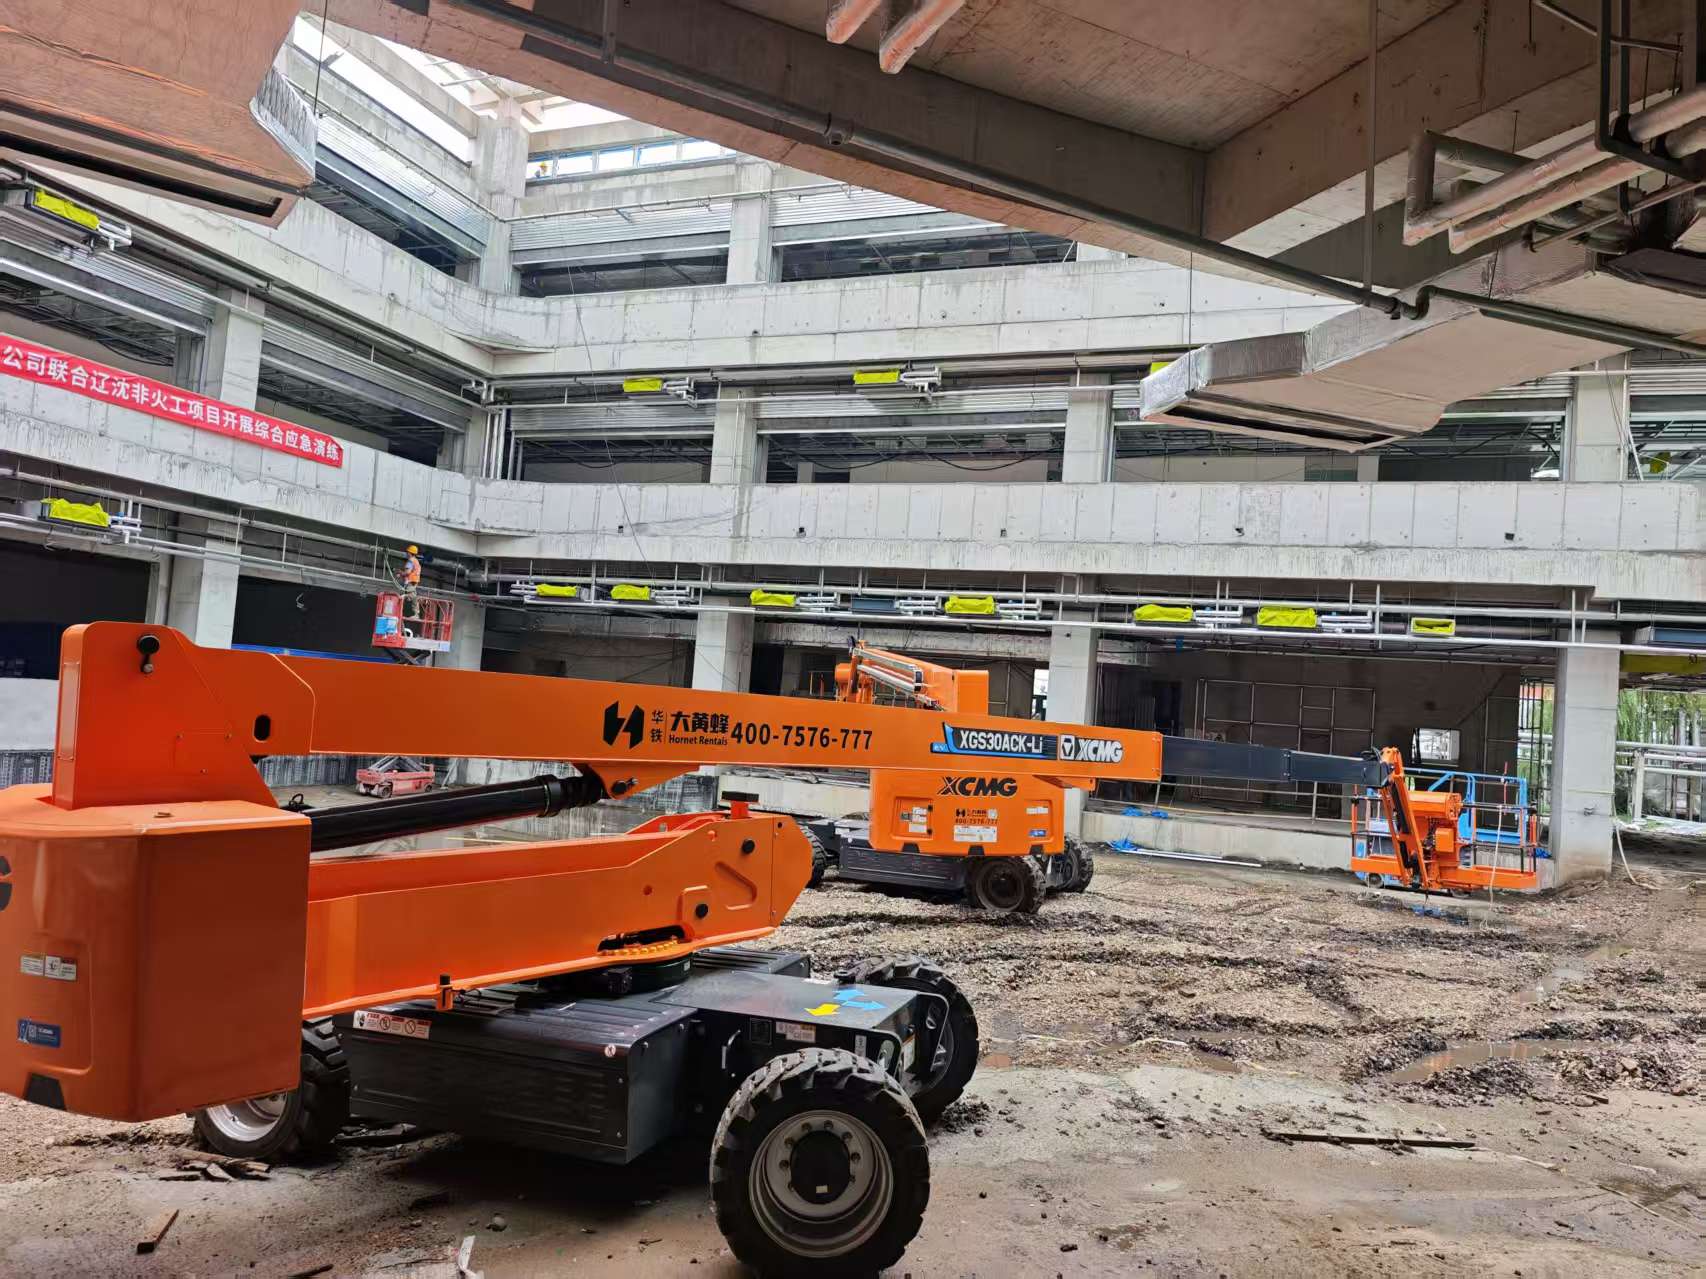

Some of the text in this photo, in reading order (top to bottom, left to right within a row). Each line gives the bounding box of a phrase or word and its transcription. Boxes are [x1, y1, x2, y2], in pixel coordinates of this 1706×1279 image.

[2, 345, 339, 461] 公司联合辽沈非火工项目开展综合应急演练
[671, 711, 729, 734] 大黄蜂
[669, 734, 728, 746] Hornet Rentals
[730, 722, 873, 750] 400-7576-777
[959, 729, 1043, 754] XGS30ACK-Li
[1075, 739, 1123, 763] XCMG
[938, 776, 1018, 797] XCMG
